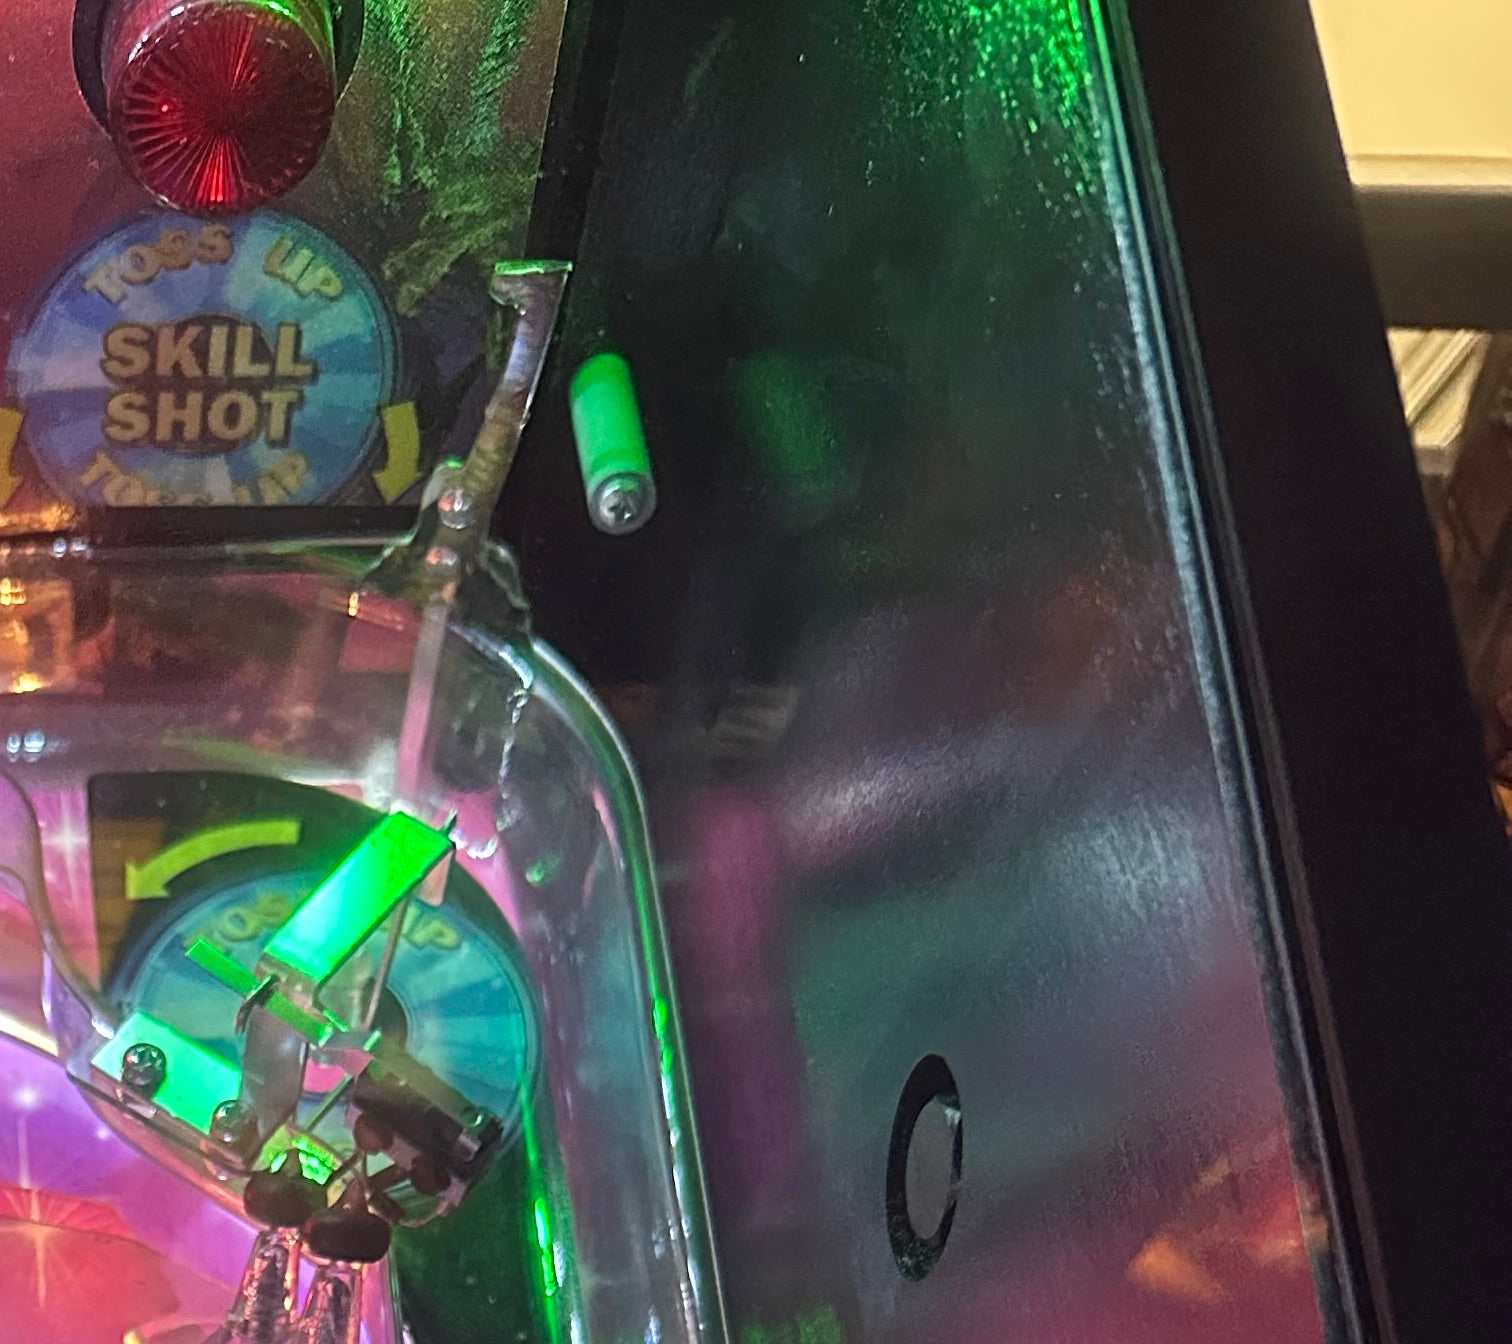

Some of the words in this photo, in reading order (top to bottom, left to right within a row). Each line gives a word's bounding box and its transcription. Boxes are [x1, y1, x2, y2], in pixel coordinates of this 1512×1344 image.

[83, 221, 234, 305] TOSS
[263, 236, 344, 302] UP
[100, 321, 317, 381] SKILL
[103, 388, 304, 444] SHOT
[80, 450, 214, 506] TO
